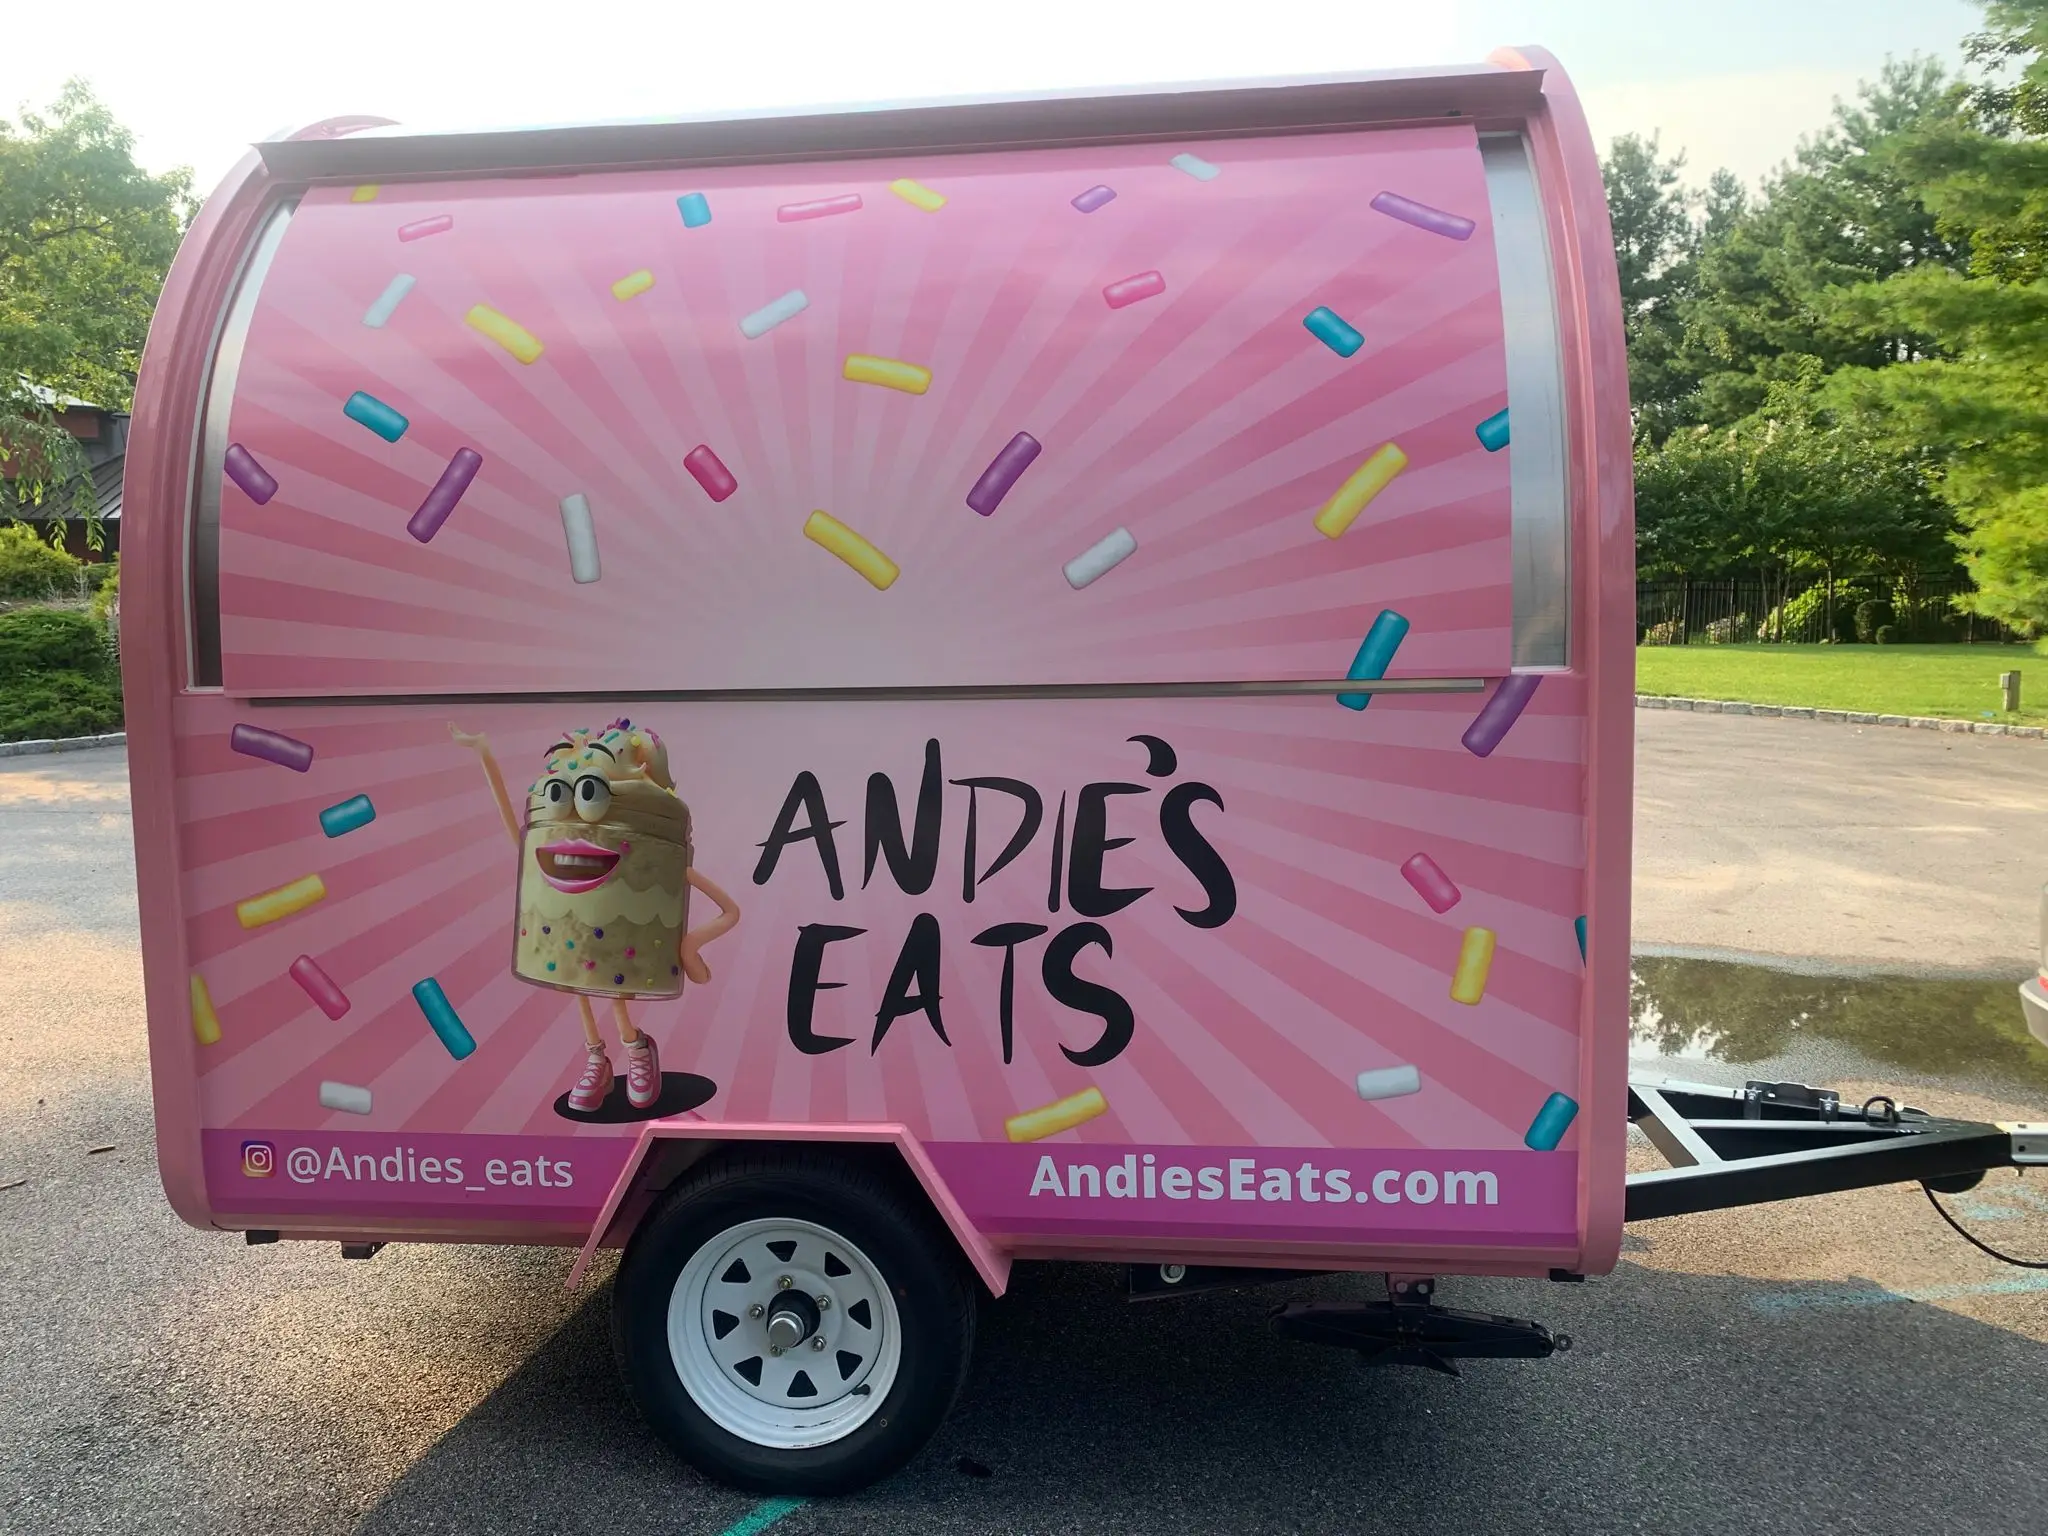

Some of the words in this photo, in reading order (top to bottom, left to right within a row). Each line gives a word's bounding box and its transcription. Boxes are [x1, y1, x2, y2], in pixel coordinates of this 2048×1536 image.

[753, 734, 1237, 929] ANDIE'S
[787, 912, 1135, 1067] EATS
[286, 1146, 574, 1192] @Andies_eats
[1029, 1153, 1499, 1205] AndiesEats.com
